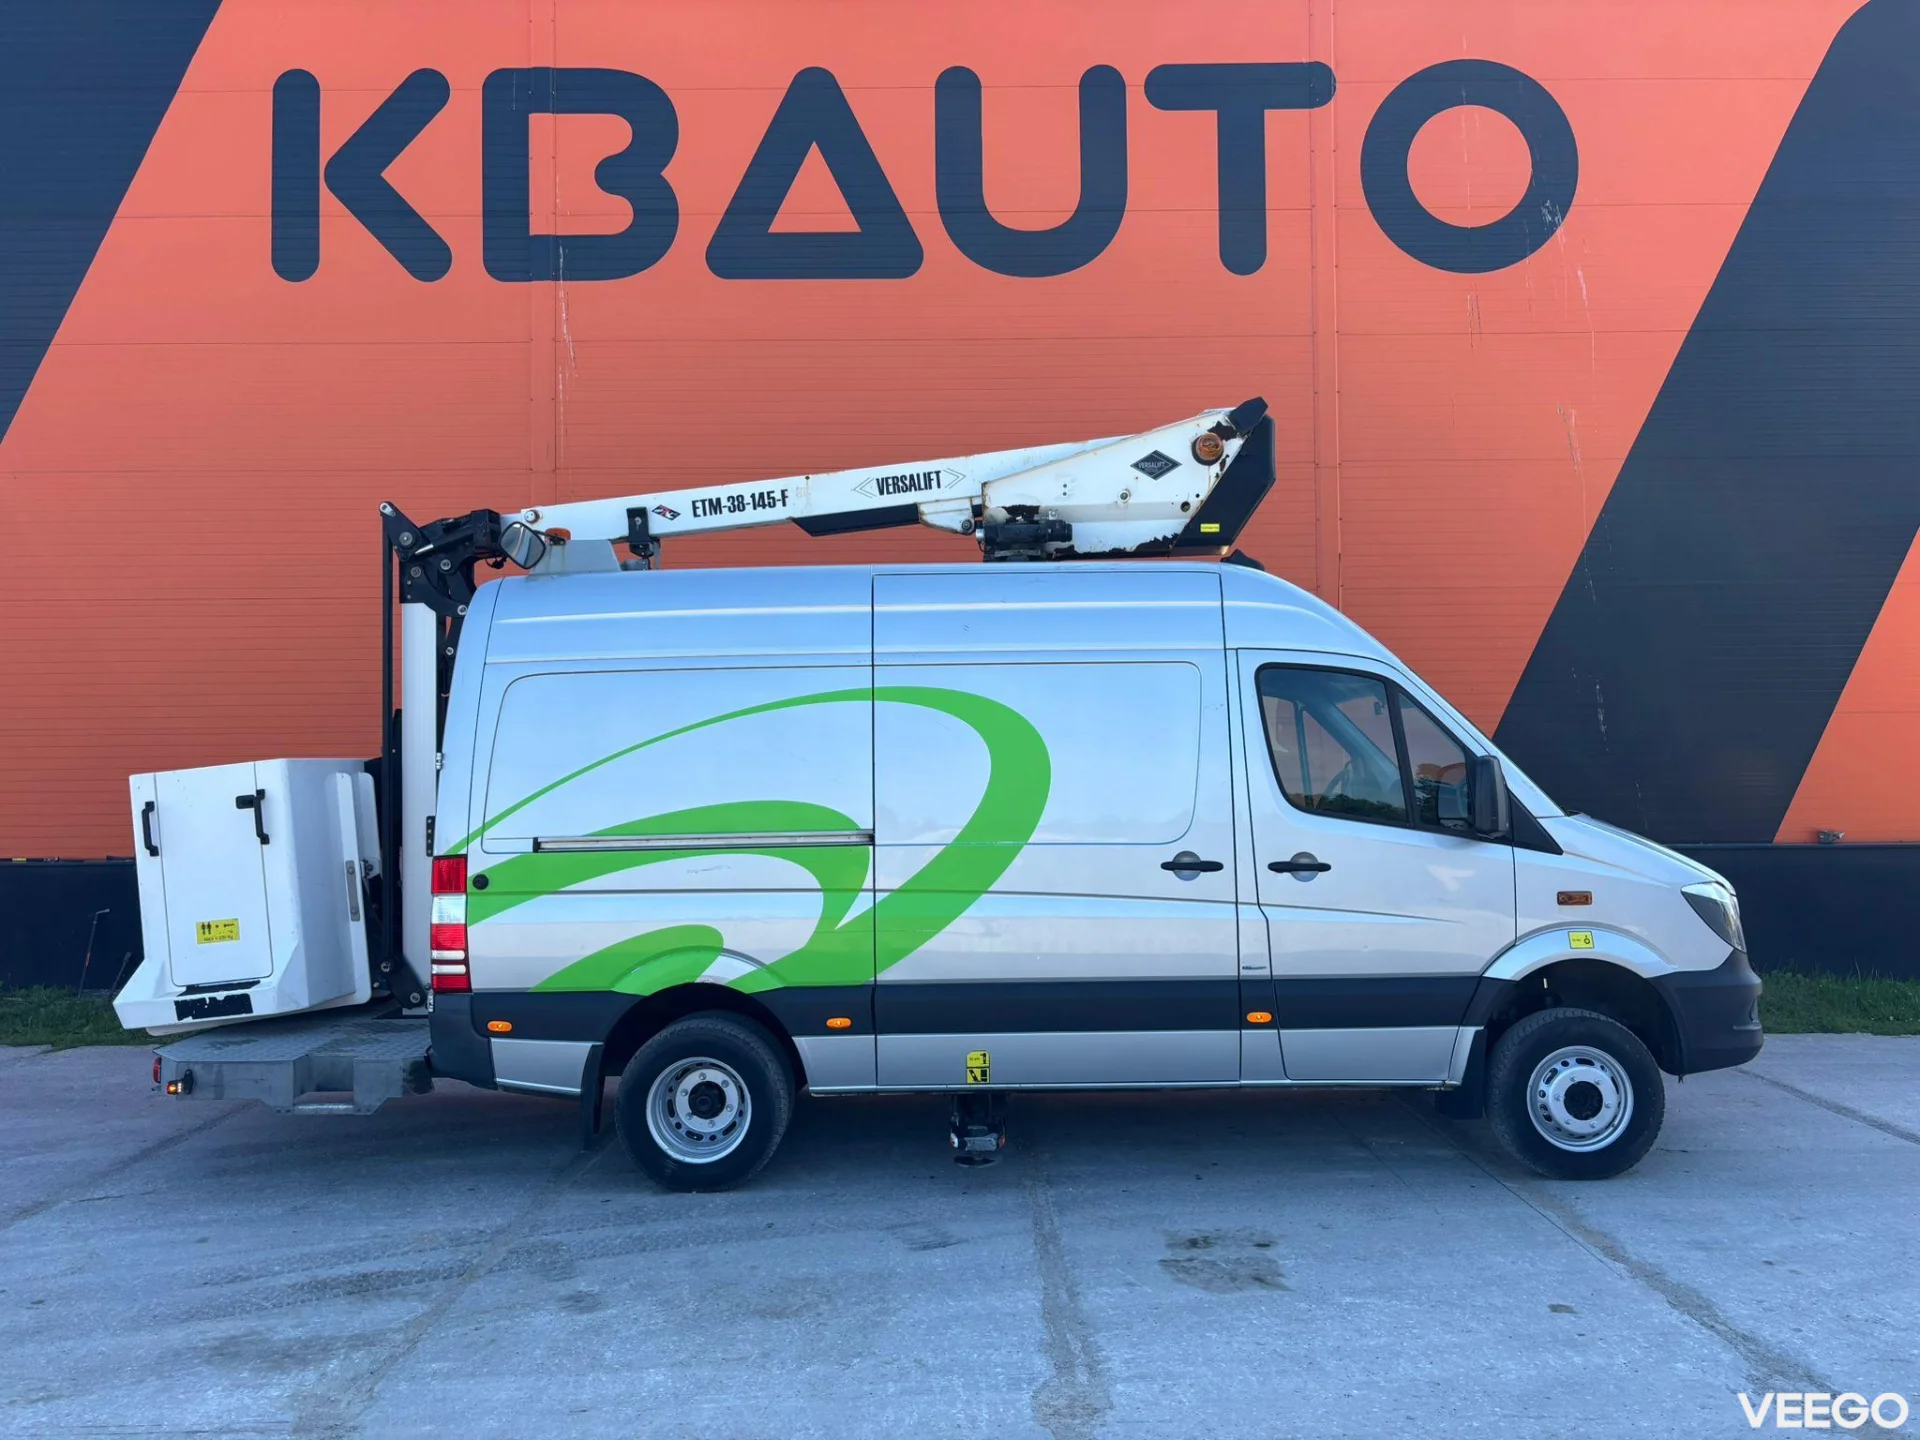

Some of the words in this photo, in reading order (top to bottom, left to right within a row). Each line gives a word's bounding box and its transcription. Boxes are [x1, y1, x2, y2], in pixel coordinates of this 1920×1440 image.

[272, 60, 1579, 283] KBAUTO
[875, 470, 942, 497] VERSALIFT
[691, 489, 789, 518] ETM-38-145-F
